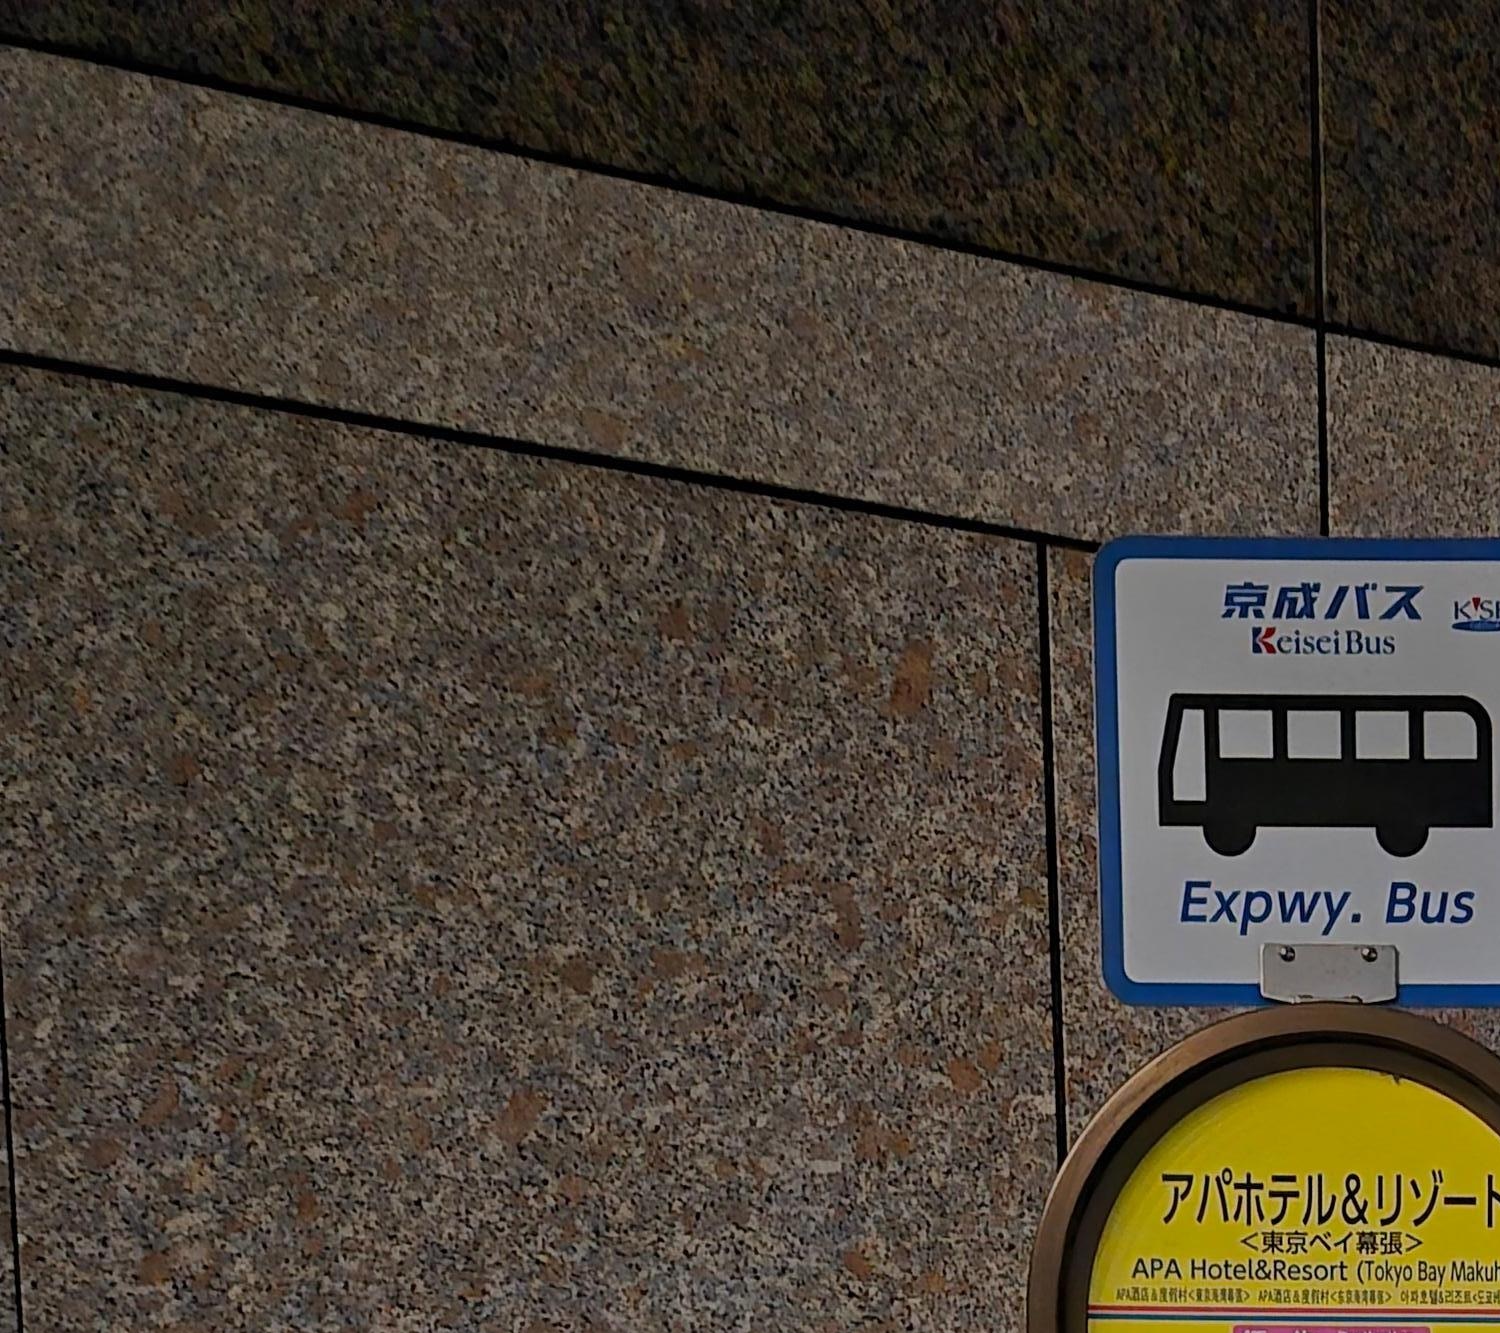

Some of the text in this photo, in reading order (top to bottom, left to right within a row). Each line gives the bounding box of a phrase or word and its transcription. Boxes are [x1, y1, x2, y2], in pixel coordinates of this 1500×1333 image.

[1221, 581, 1424, 620] 京成バス
[1252, 626, 1396, 655] Keisei Bus
[1180, 881, 1475, 936] Expwy. Bus
[1132, 1259, 1182, 1281] APA
[1190, 1258, 1348, 1281] Hotel&Resort
[1356, 1260, 1413, 1288] (Tokyo
[1417, 1261, 1446, 1288] Bay
